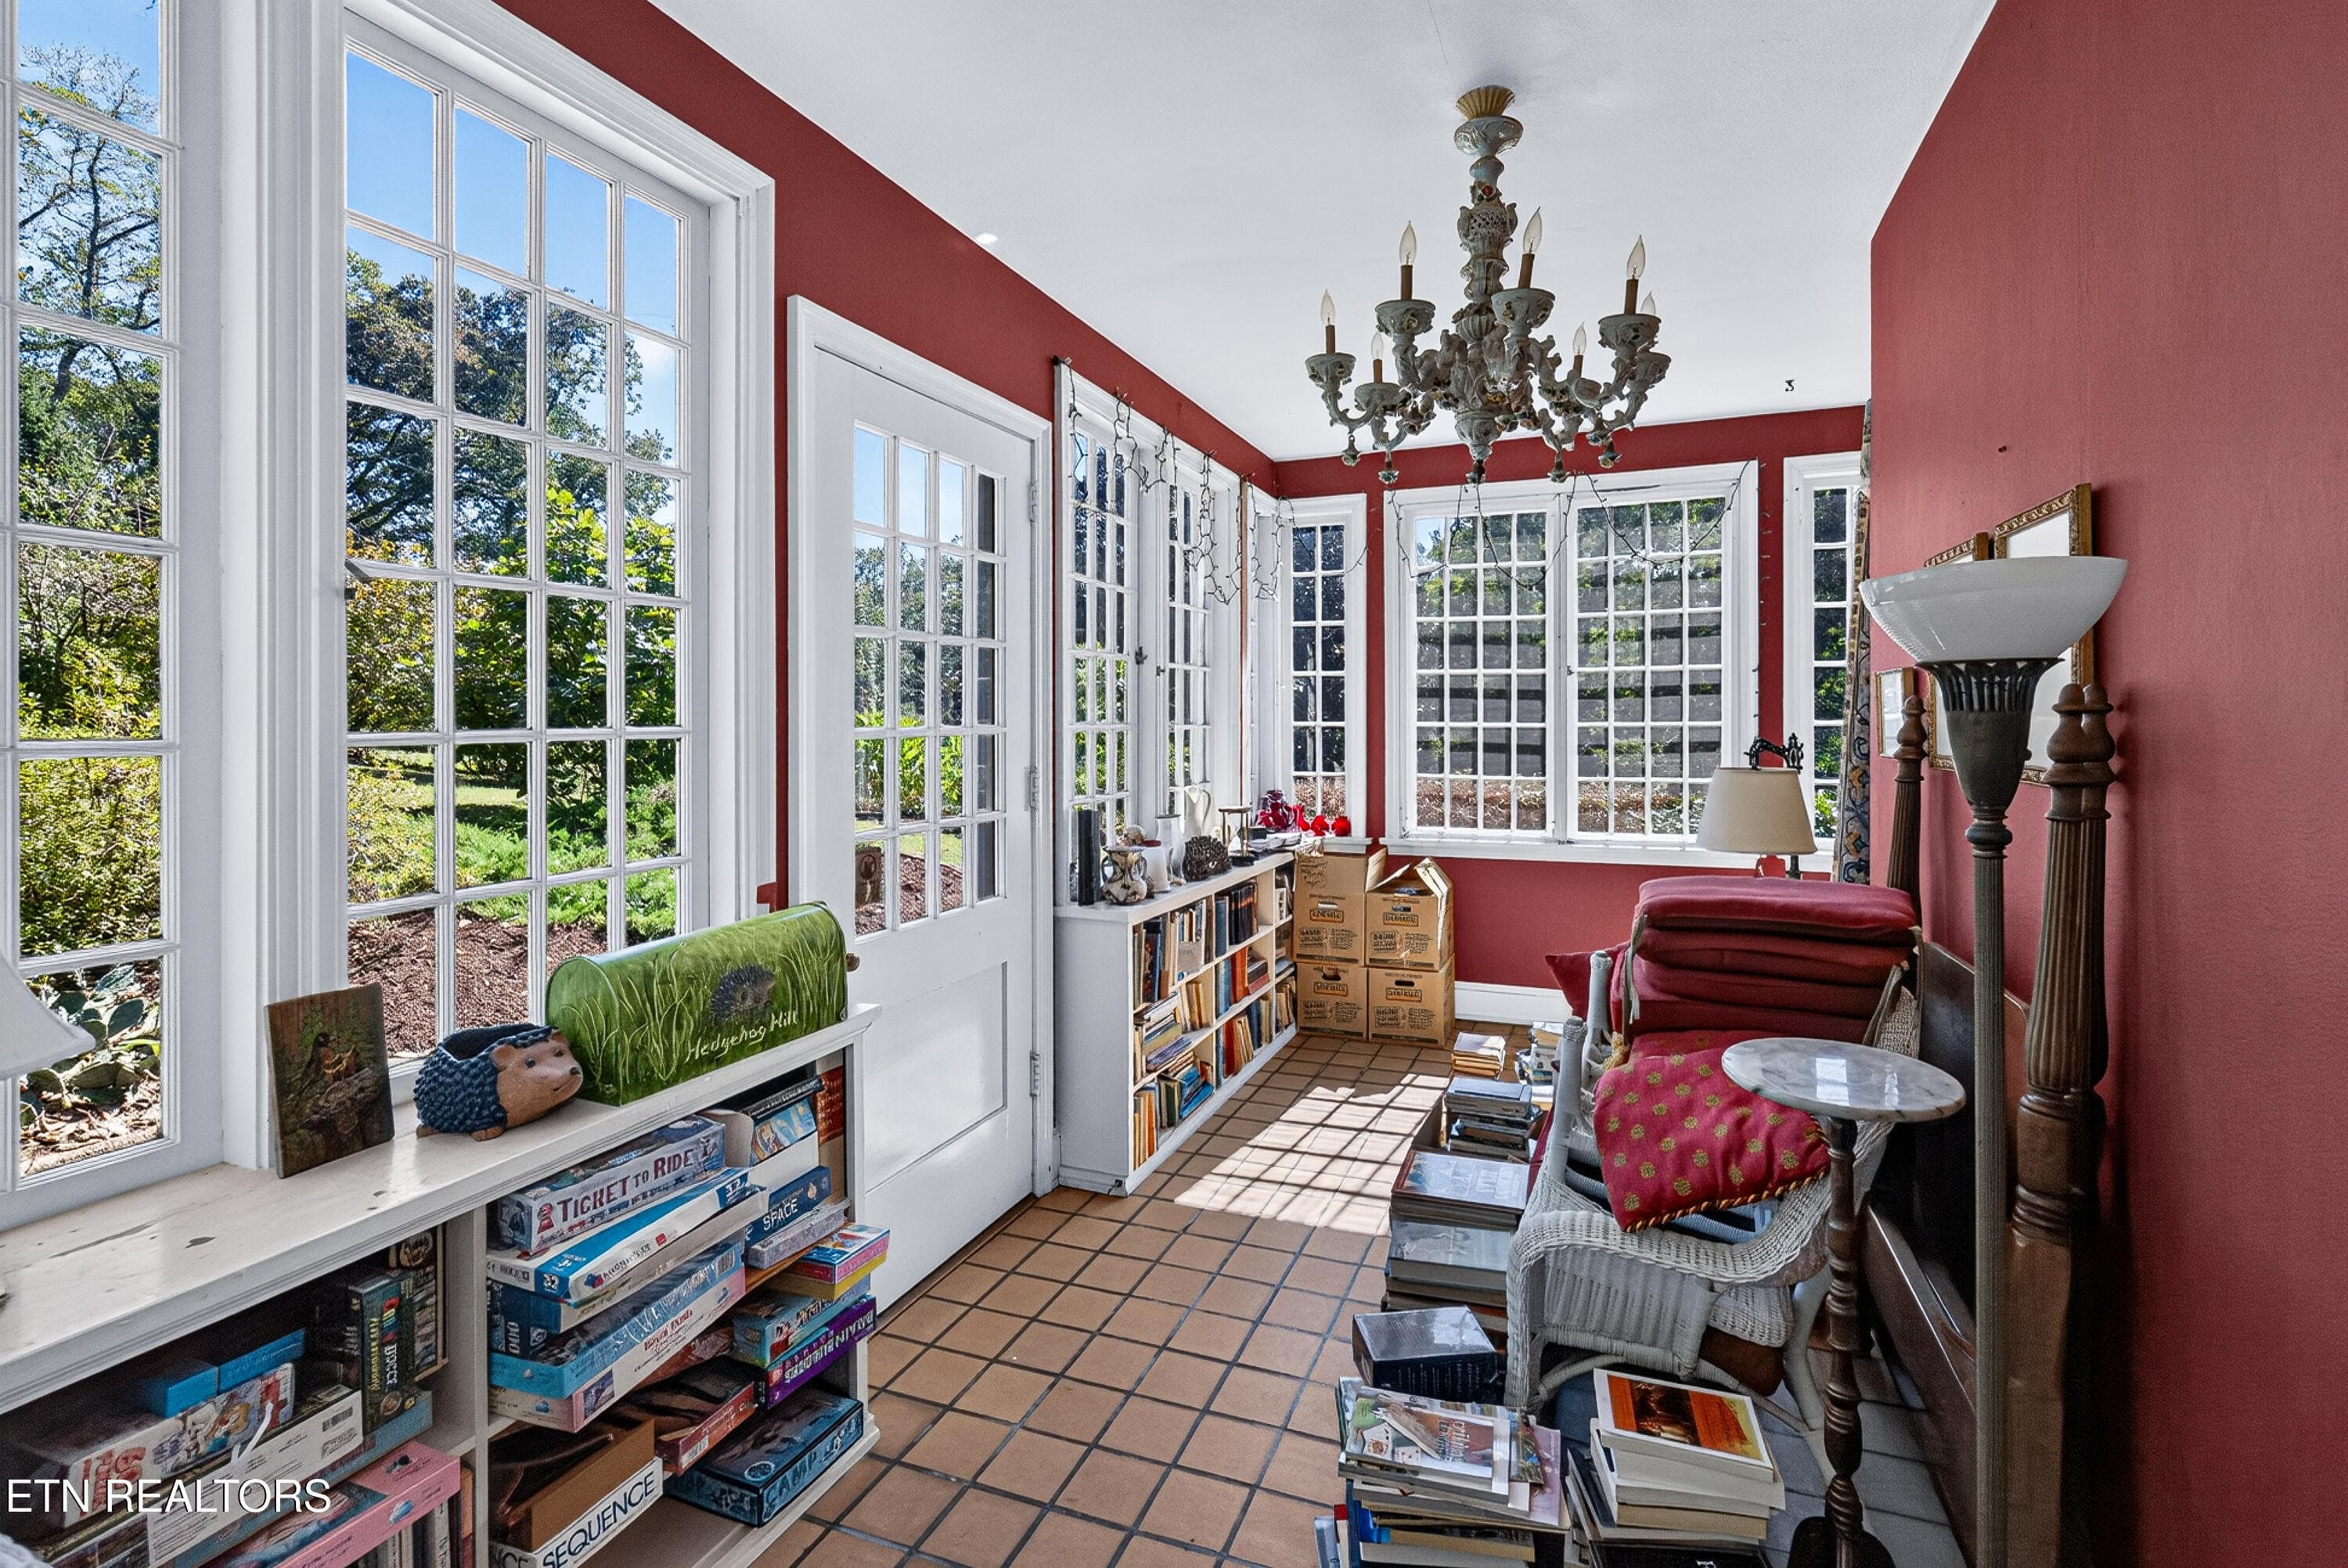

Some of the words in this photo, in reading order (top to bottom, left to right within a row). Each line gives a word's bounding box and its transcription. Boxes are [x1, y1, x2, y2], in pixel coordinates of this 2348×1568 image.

[683, 1025, 766, 1064] Hedgehog
[769, 1009, 798, 1031] Hill
[556, 1175, 631, 1222] TICKET
[633, 1170, 649, 1188] TO
[654, 1149, 694, 1180] RIDE
[762, 1199, 798, 1232] SPACE
[542, 1471, 656, 1568] SEQUENCE
